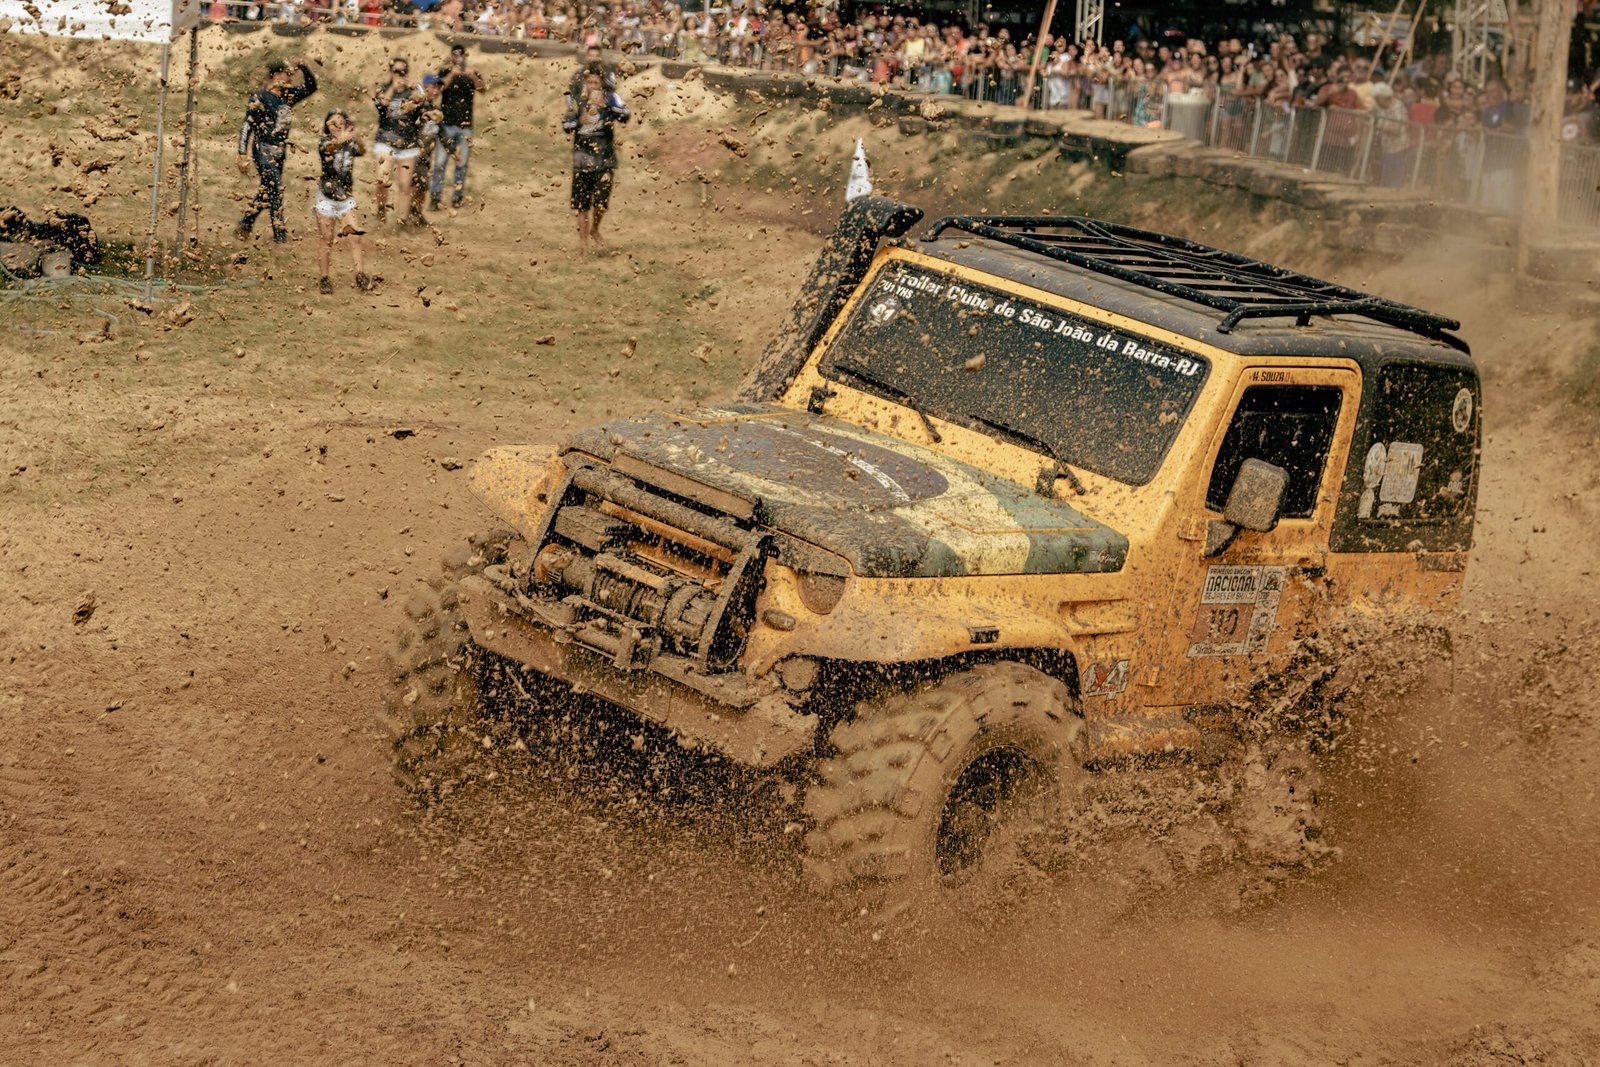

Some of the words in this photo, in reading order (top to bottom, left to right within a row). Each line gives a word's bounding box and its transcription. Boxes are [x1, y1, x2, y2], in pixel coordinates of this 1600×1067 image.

[994, 300, 1016, 318] de
[1019, 308, 1052, 329] São
[1054, 320, 1094, 343] João
[1096, 334, 1119, 352] da
[1122, 340, 1200, 377] Barra-RJ
[1261, 371, 1285, 382] SOUZA
[1206, 575, 1256, 592] NACIONAL
